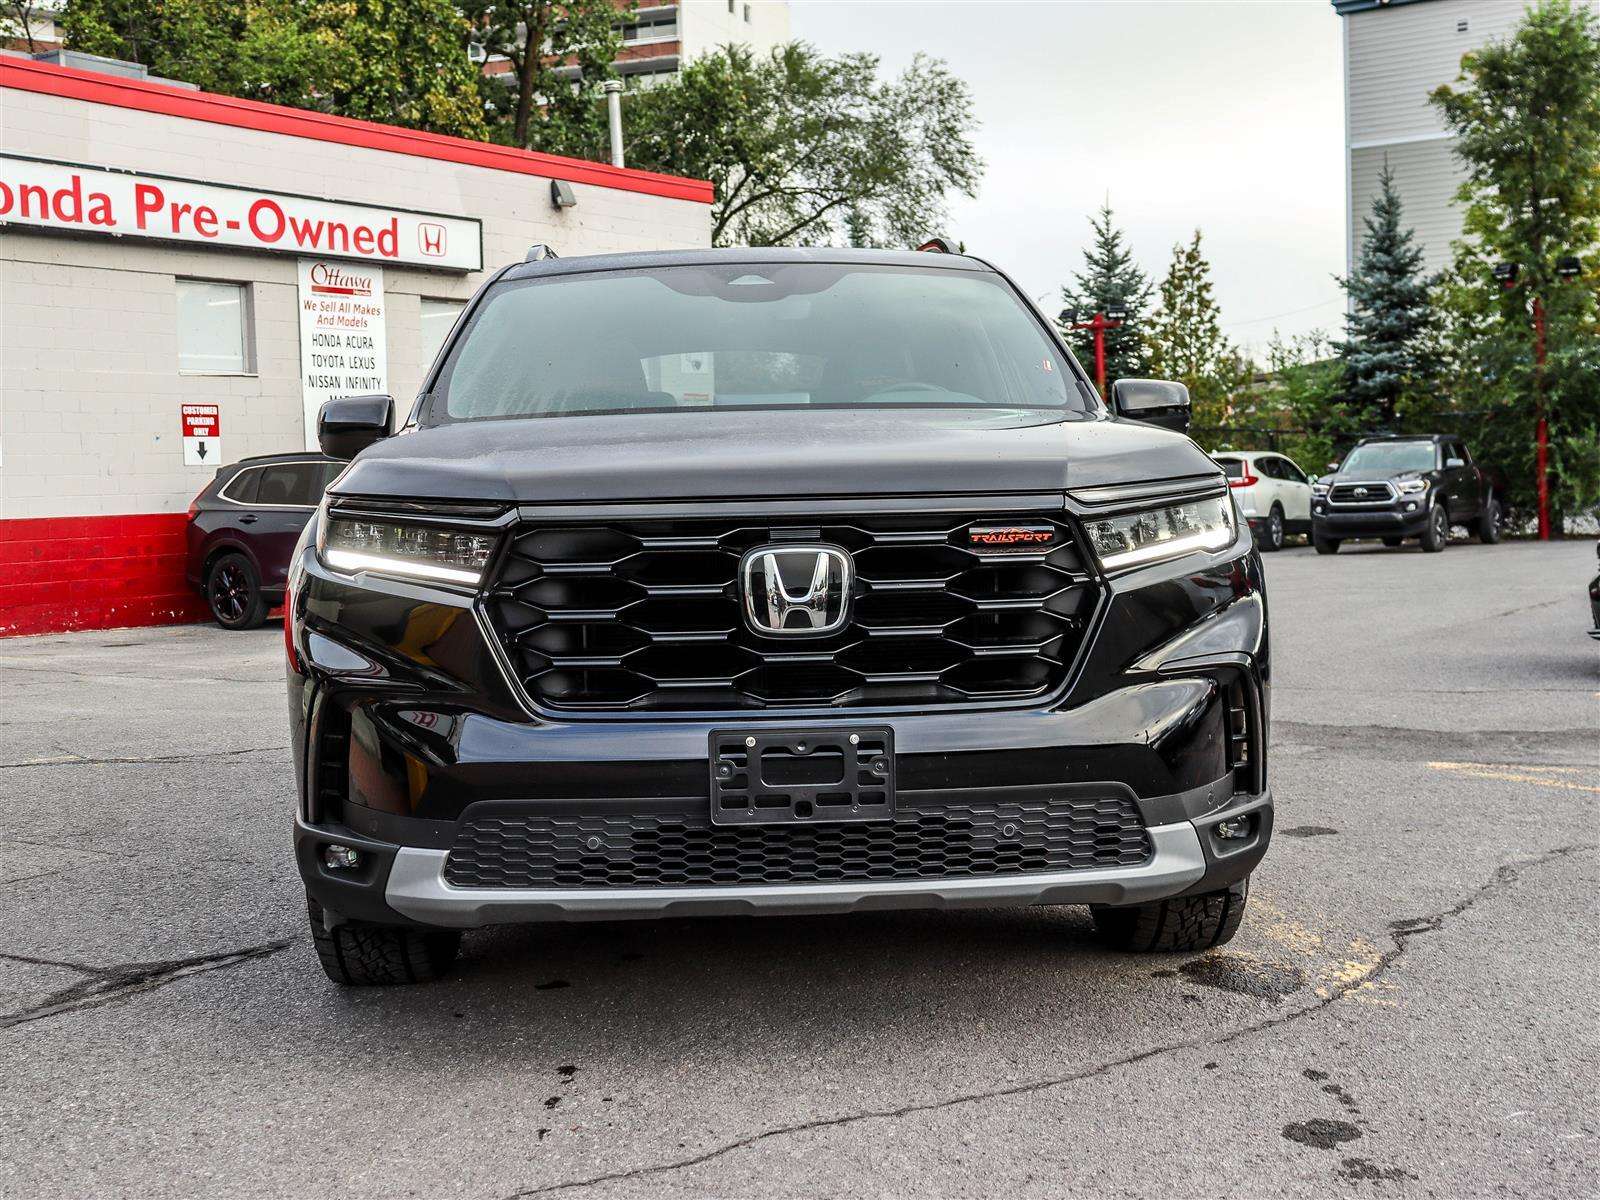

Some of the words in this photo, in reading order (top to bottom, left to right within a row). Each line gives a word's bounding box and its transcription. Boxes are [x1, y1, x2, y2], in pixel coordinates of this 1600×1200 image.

[134, 183, 400, 258] Pre-Owned
[311, 263, 372, 288] Ottawa
[303, 300, 317, 311] We
[320, 301, 336, 313] Sell
[338, 302, 351, 313] All
[353, 304, 381, 316] Makes
[317, 314, 335, 326] And
[337, 316, 368, 328] Models
[312, 333, 341, 348] HONDA
[346, 335, 374, 349] ACURA
[312, 354, 345, 369] TOYOTA
[349, 356, 376, 370] LEXUS
[308, 375, 341, 389] NISSAN
[345, 376, 382, 390] INFINITY
[187, 416, 215, 426] PARKING
[194, 427, 209, 436] ONLY
[970, 533, 1053, 544] TRAILSPORT
